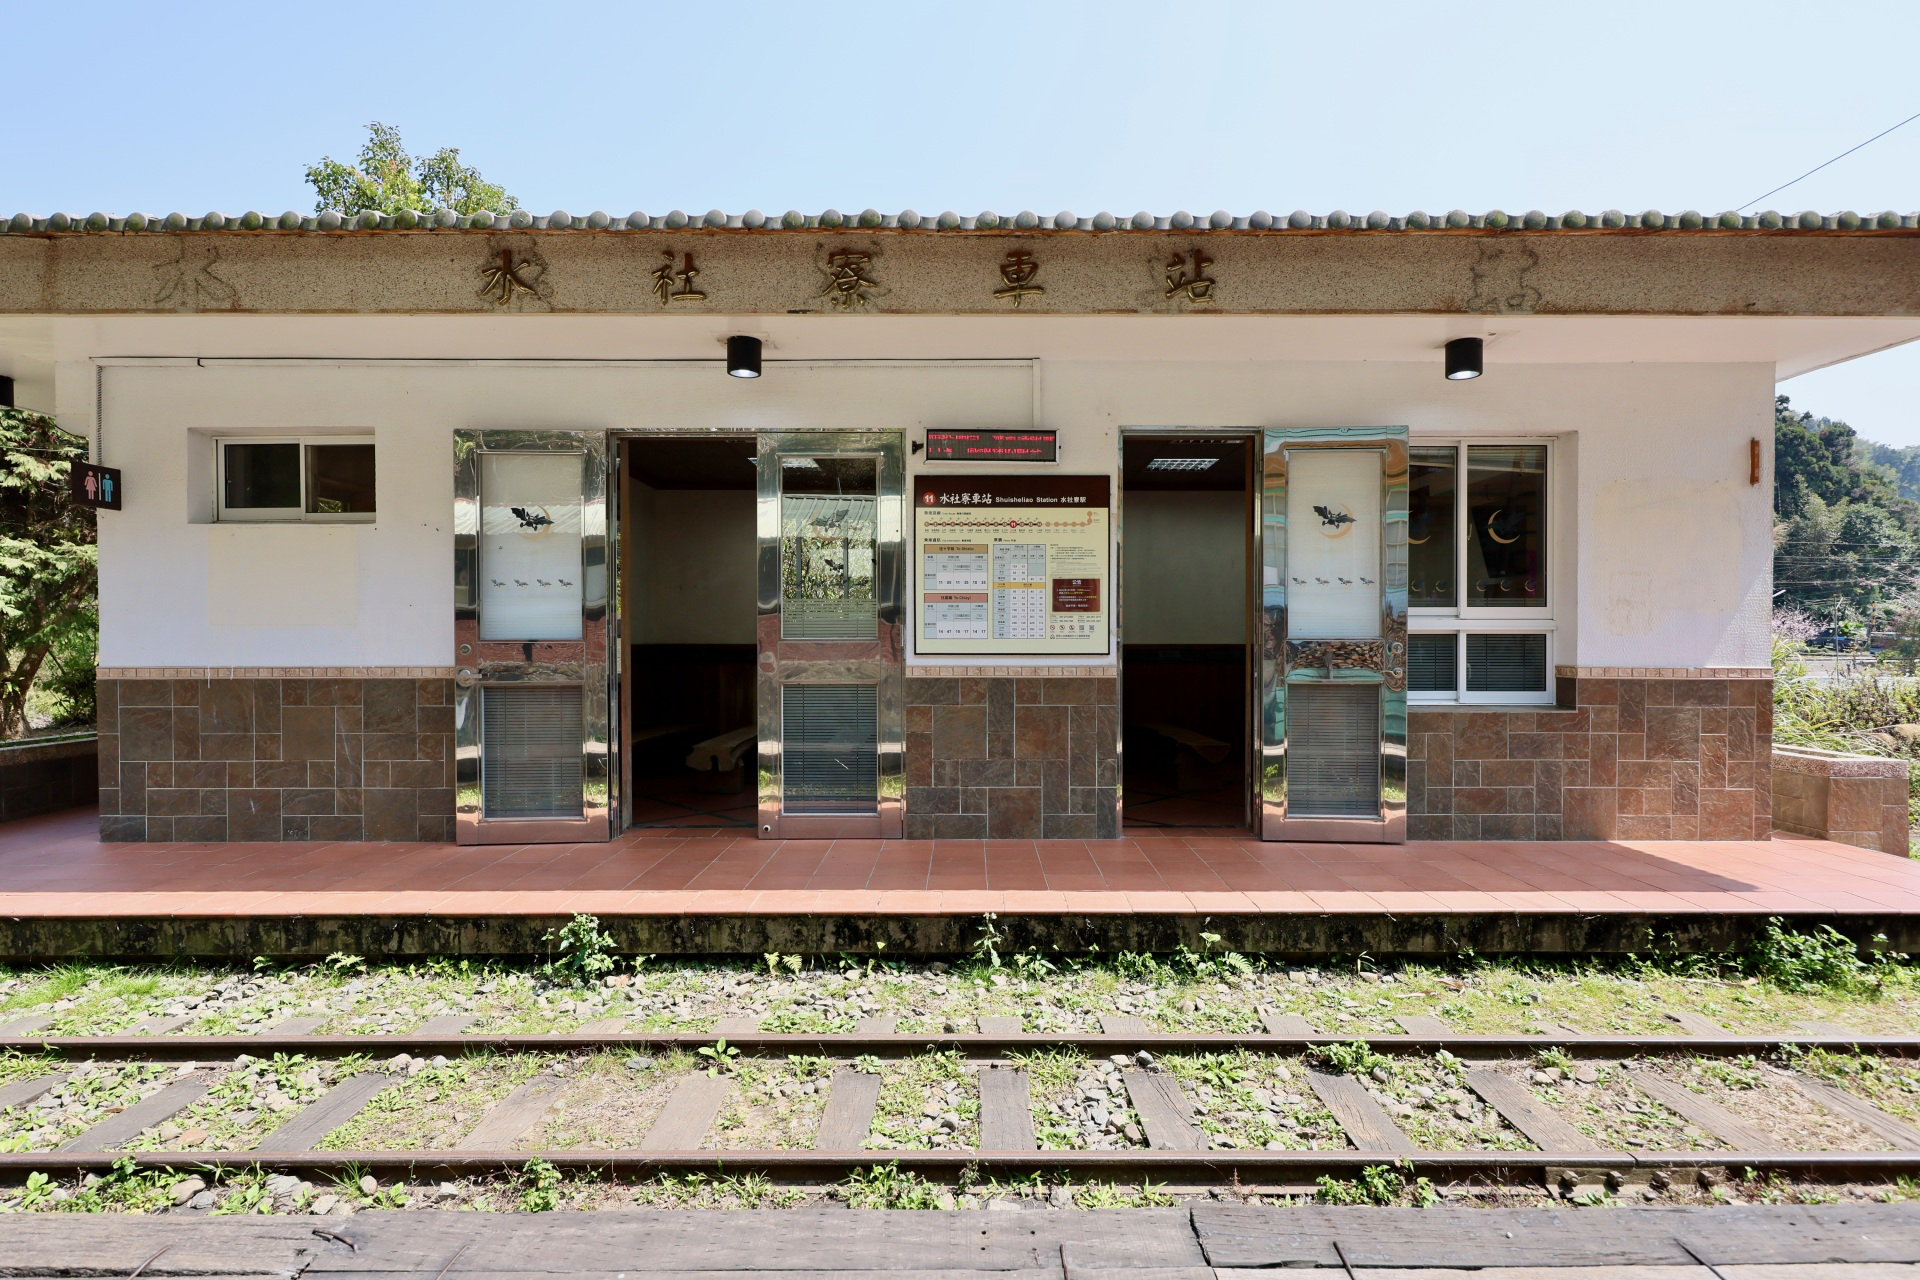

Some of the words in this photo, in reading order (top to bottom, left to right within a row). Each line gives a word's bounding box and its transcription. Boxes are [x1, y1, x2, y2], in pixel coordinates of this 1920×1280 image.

[481, 247, 1217, 310] 水社寮車站
[924, 495, 934, 503] 11
[940, 492, 992, 504] 水社寮車站
